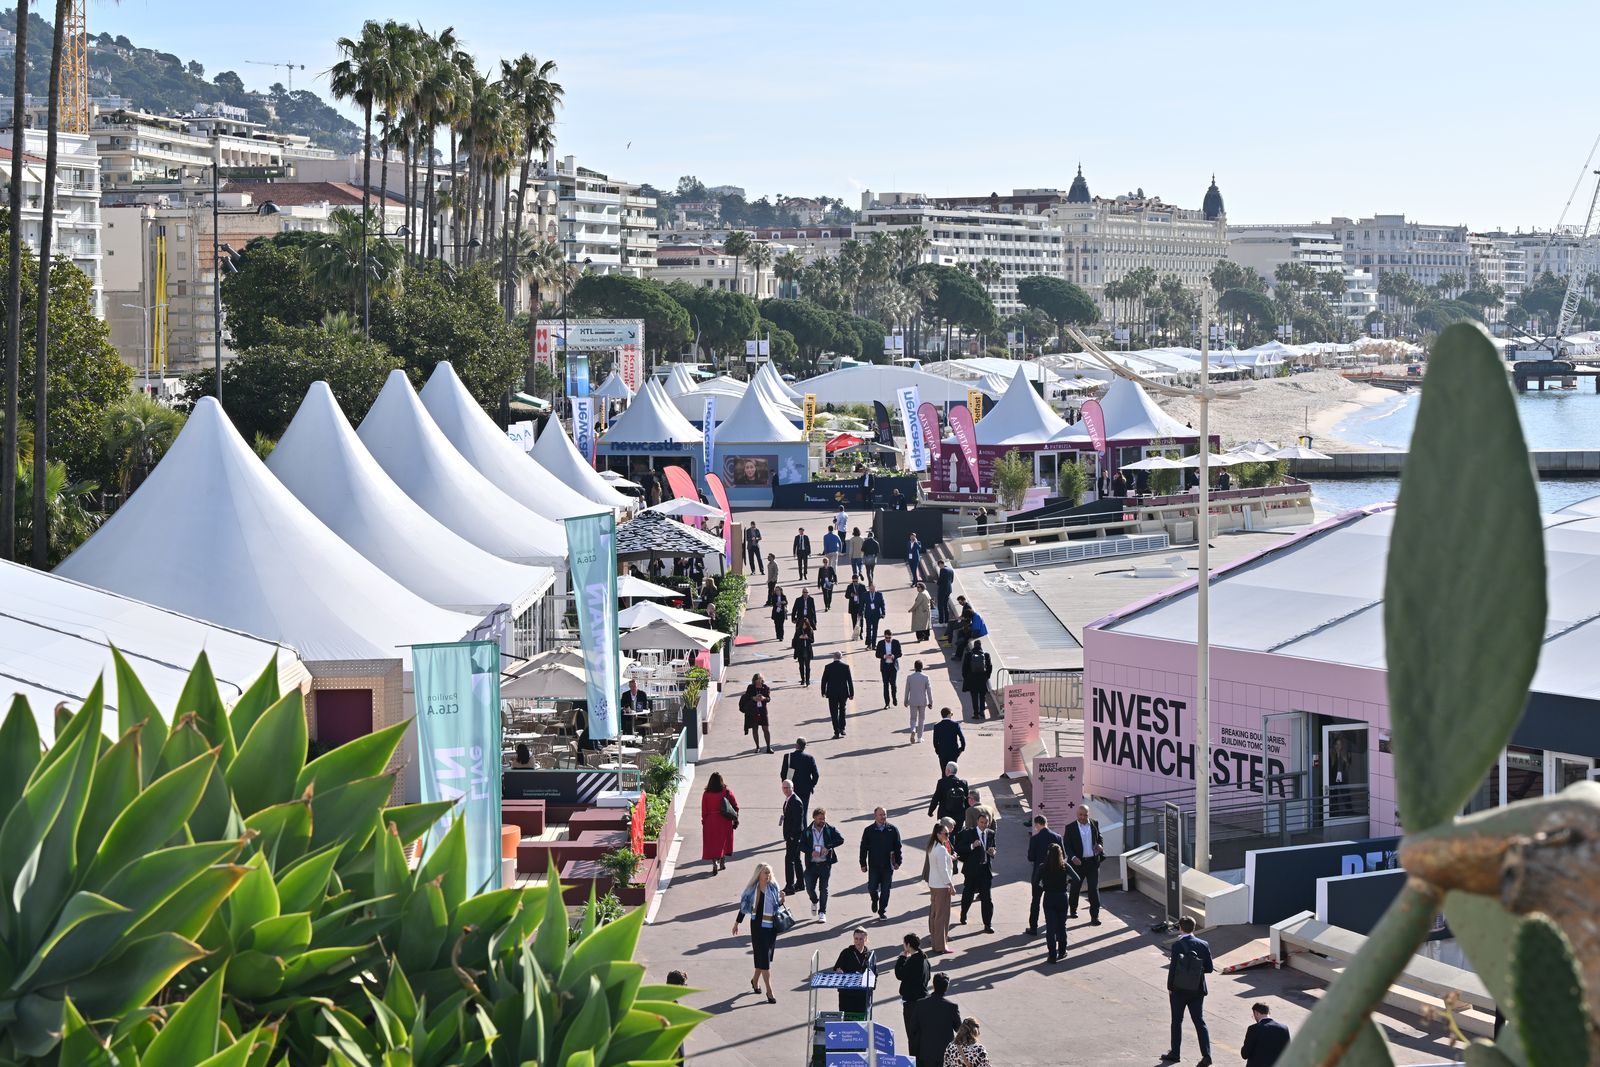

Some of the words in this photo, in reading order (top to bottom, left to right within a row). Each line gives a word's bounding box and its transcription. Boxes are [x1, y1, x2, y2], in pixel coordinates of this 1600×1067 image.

[1221, 727, 1249, 739] BREAKING
[1249, 732, 1287, 747] BOUARIES,
[1221, 737, 1247, 748] BUILDING
[1247, 741, 1281, 754] TOMOROW
[1093, 726, 1286, 798] MANCHSTER
